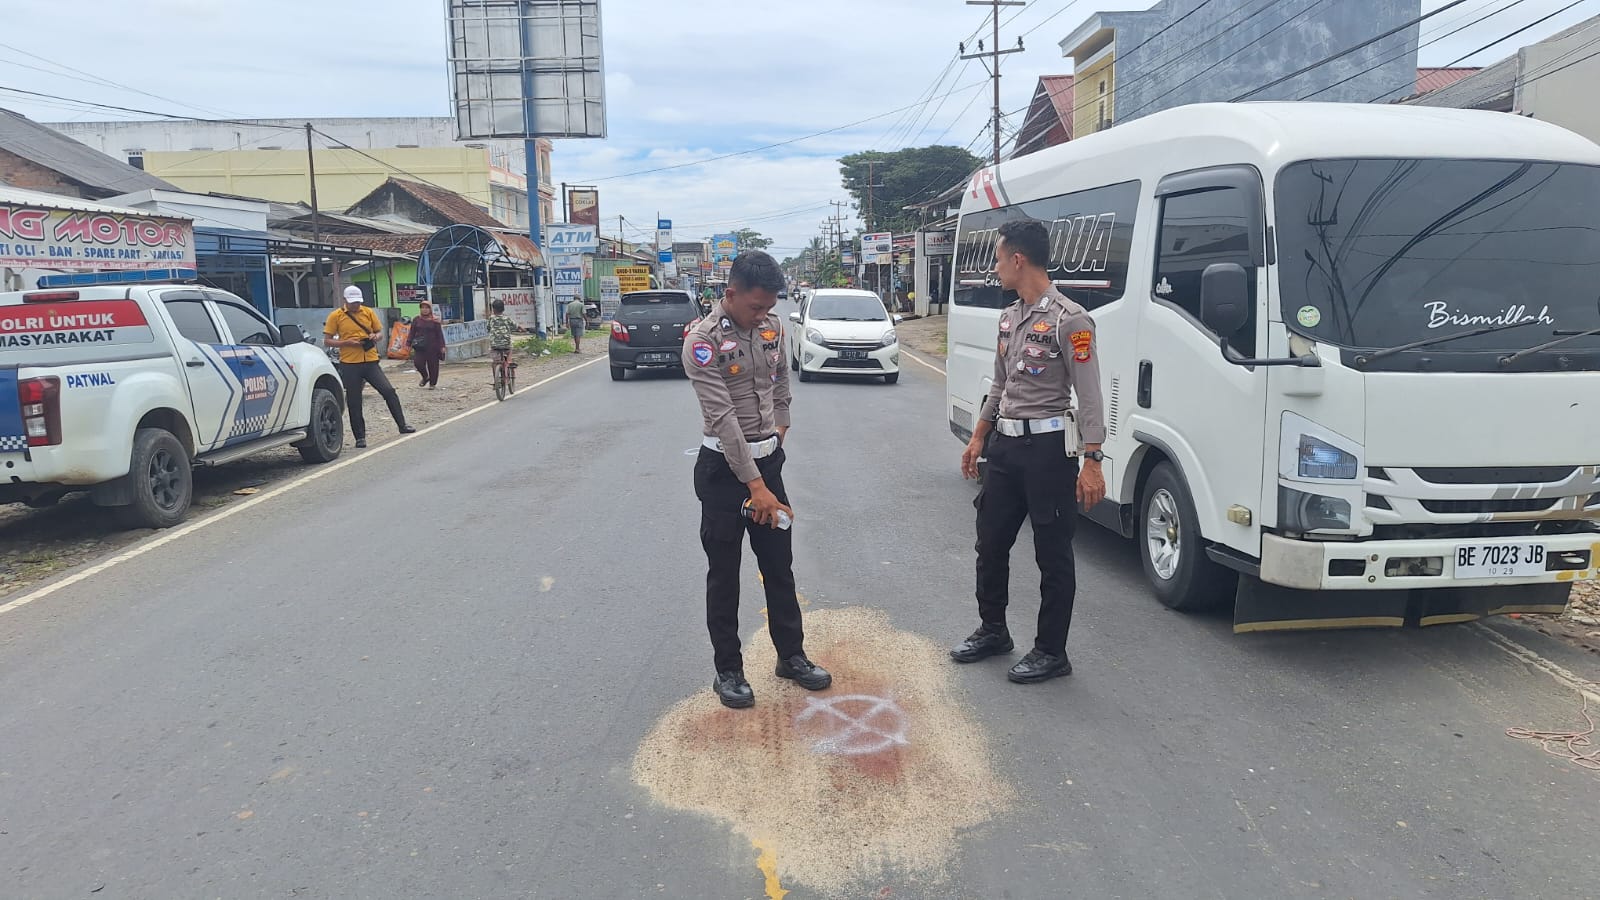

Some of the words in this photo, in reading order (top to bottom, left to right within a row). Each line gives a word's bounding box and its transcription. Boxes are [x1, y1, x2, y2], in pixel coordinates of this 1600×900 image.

[54, 211, 186, 247] MOTOR
[551, 231, 592, 243] ATM
[14, 244, 36, 257] OLI
[48, 245, 73, 257] BAN
[83, 247, 115, 259] SPARE
[118, 248, 141, 260] PART
[555, 271, 581, 280] ATM
[502, 292, 536, 306] BAROKA
[0, 317, 44, 331] OLRI
[50, 313, 115, 328] UNTUK
[1423, 301, 1554, 329] Bismillah
[1025, 333, 1052, 344] POLRI
[66, 372, 116, 389] PATWAL
[244, 376, 267, 392] POLISI
[1458, 547, 1476, 567] BE
[1481, 545, 1518, 566] 7023
[1525, 545, 1544, 564] JB
[1503, 567, 1513, 575] 29
